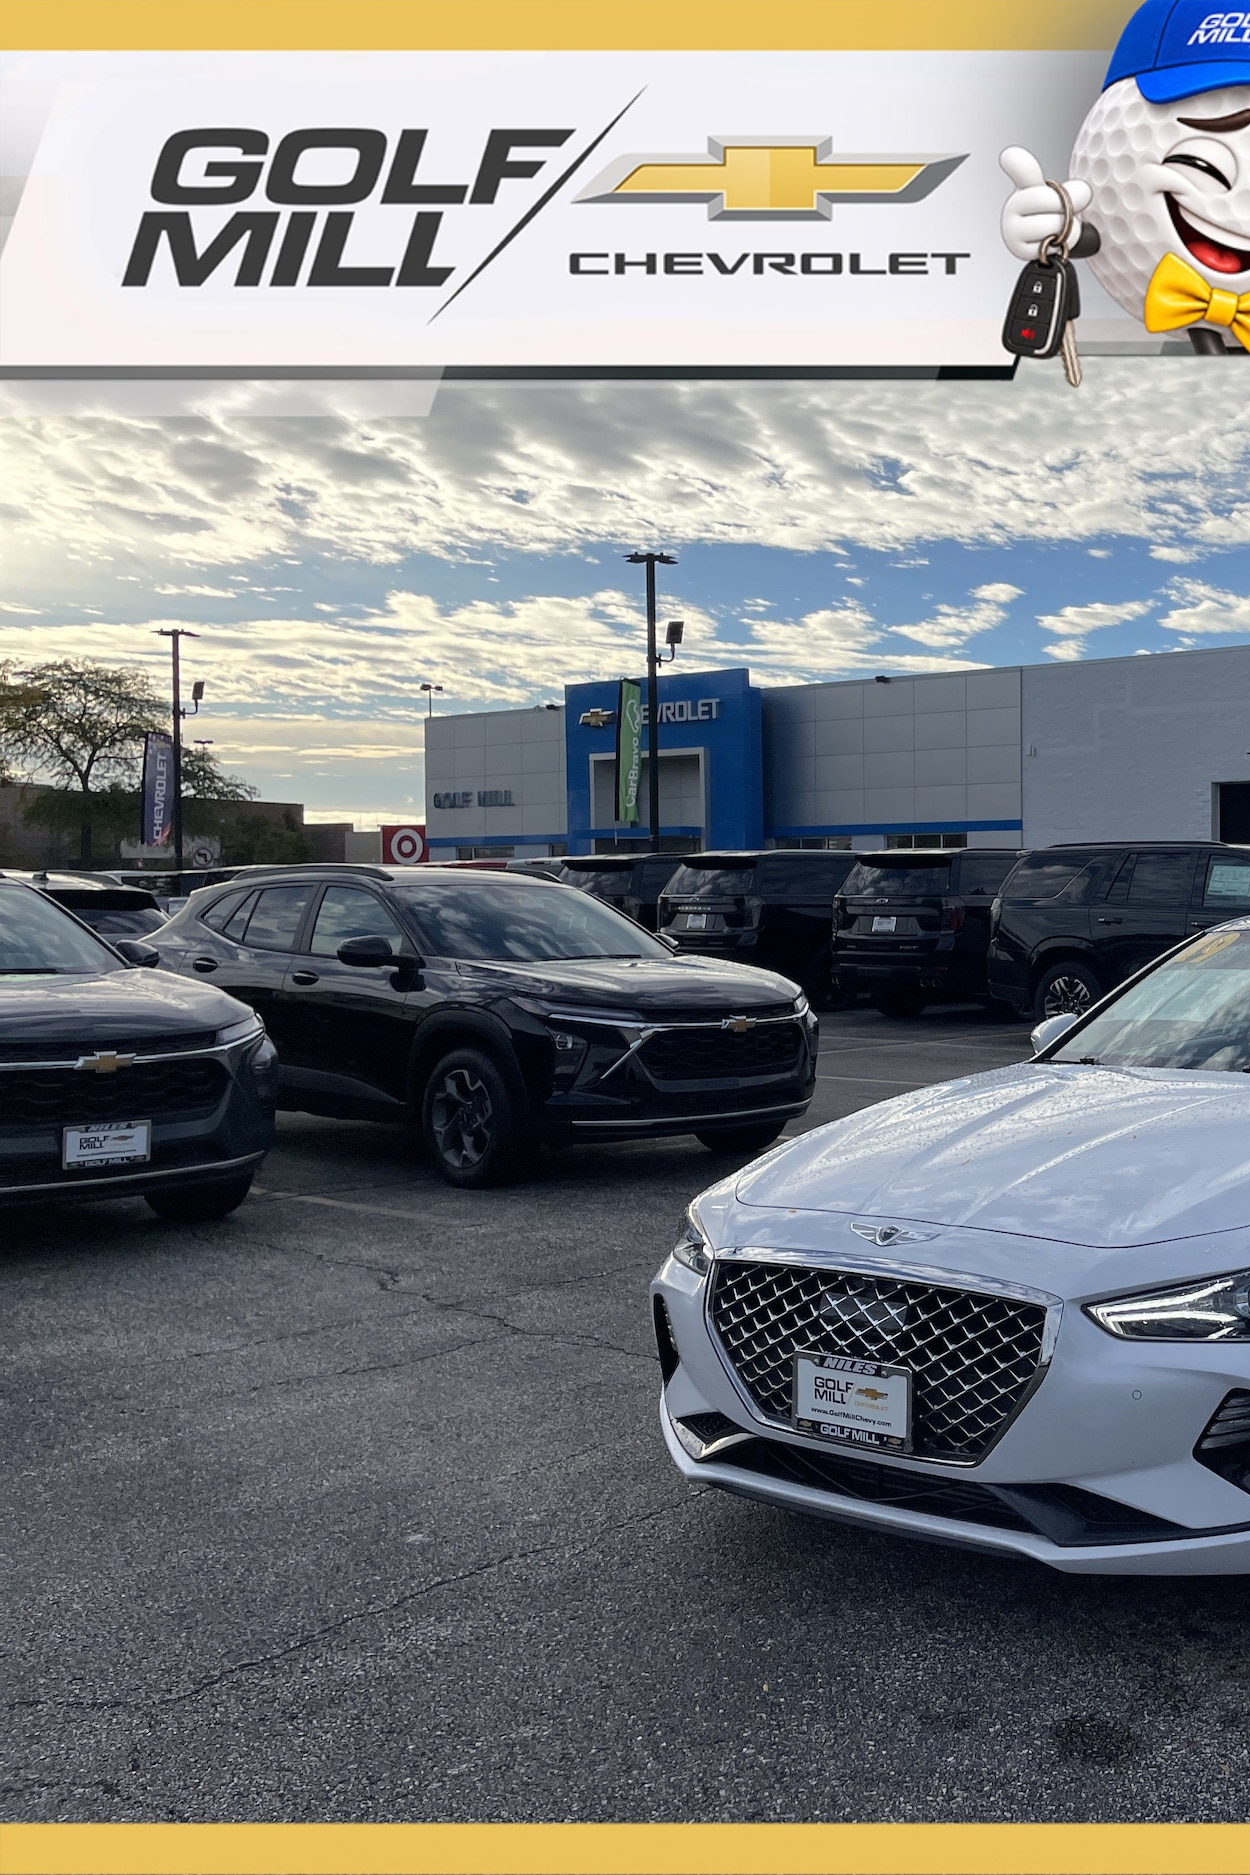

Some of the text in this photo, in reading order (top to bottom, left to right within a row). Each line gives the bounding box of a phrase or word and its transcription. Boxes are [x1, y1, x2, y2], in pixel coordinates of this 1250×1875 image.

[626, 736, 640, 808] CarBravo
[153, 752, 167, 840] CHEVROLET
[80, 1142, 104, 1150] MILL
[824, 1357, 877, 1375] NILES
[814, 1376, 854, 1393] GOLF
[814, 1387, 847, 1405] MILL
[810, 1407, 892, 1428] www.GolfMillChevy.com
[820, 1424, 880, 1444] GOLF MILL
